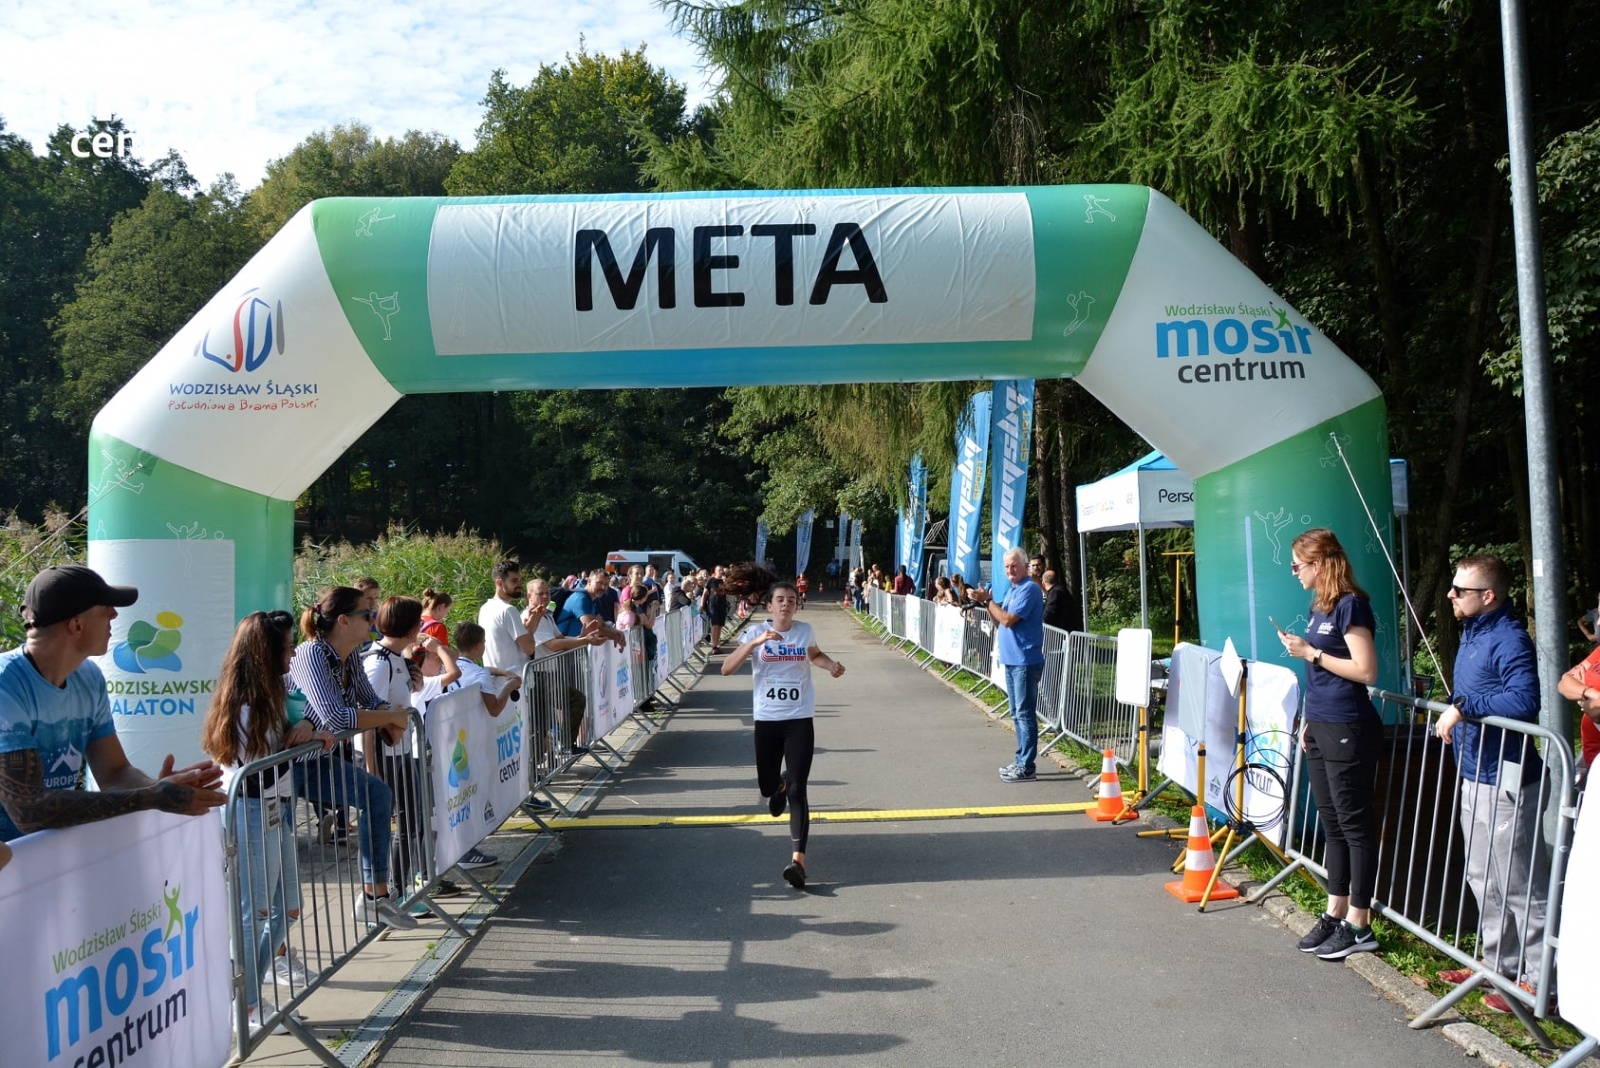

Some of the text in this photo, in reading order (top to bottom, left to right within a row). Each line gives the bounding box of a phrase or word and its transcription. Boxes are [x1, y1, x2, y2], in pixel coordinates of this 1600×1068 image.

[575, 223, 888, 311] META
[1164, 301, 1271, 318] Wodzisław Śląski
[1155, 318, 1312, 358] mosir
[1177, 358, 1306, 384] centrum
[170, 380, 318, 397] WODZISŁAW ŚLĄSKI
[239, 399, 278, 410] Brama
[1020, 410, 1031, 462] SPORT
[973, 459, 984, 500] SPORT
[106, 680, 216, 695] ODZISŁAWSKI
[766, 687, 799, 701] 460
[111, 698, 195, 715] ALATON
[44, 774, 79, 788] UROPE
[52, 900, 162, 974] Wodzisław Śląski
[45, 904, 199, 1062] mosir
